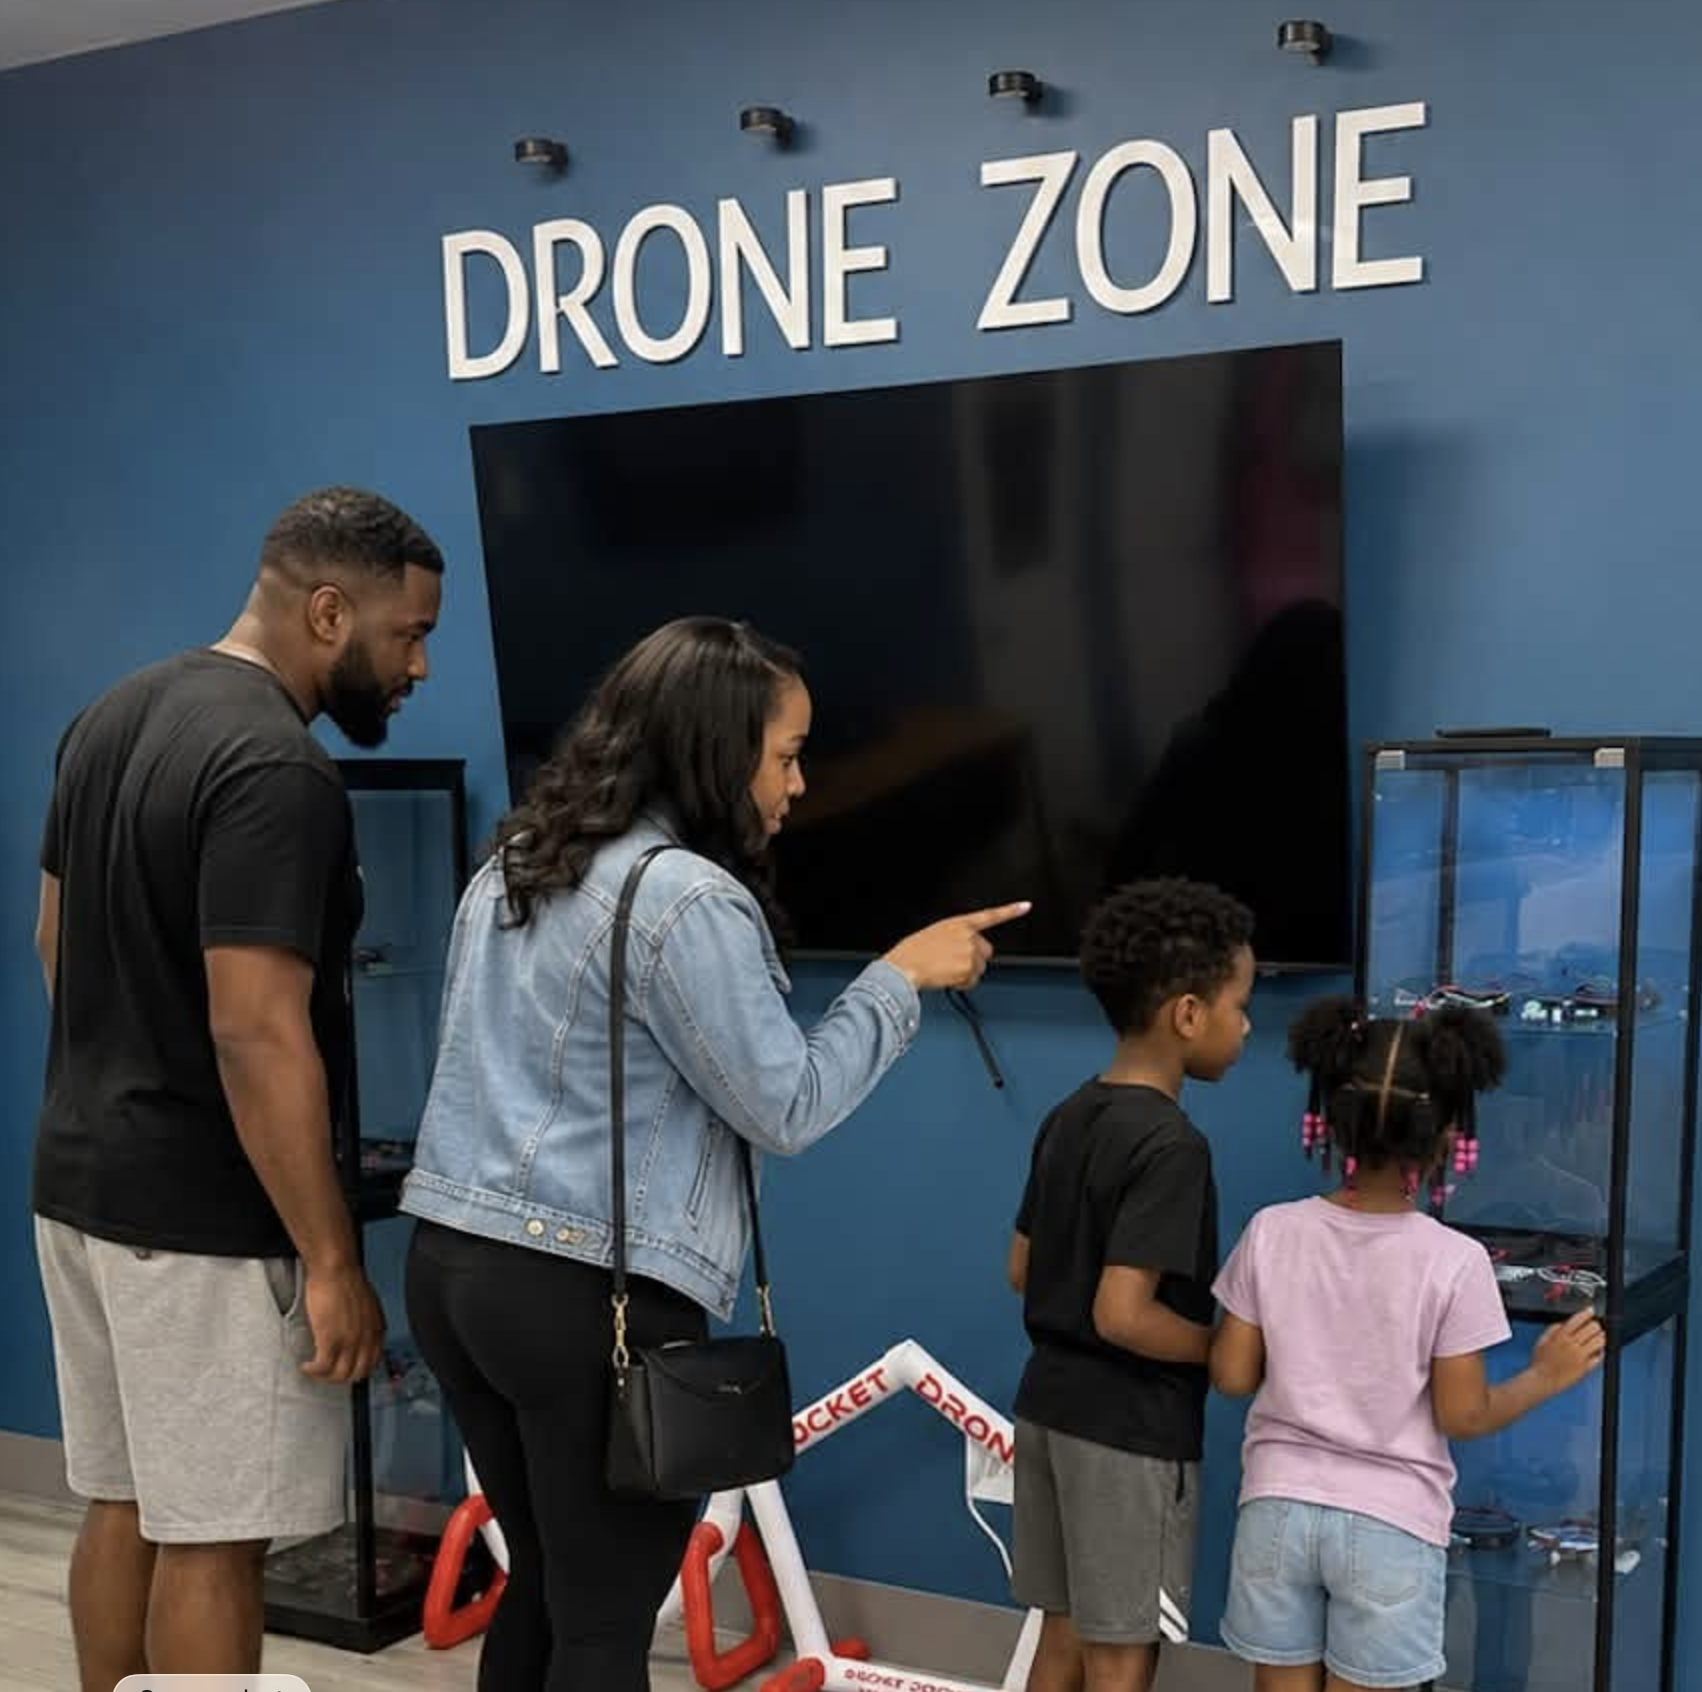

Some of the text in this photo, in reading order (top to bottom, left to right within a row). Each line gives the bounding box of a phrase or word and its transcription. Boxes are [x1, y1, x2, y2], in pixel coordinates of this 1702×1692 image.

[442, 102, 1427, 380] DRONE ZONE
[793, 1368, 1014, 1463] OCKET DRON
